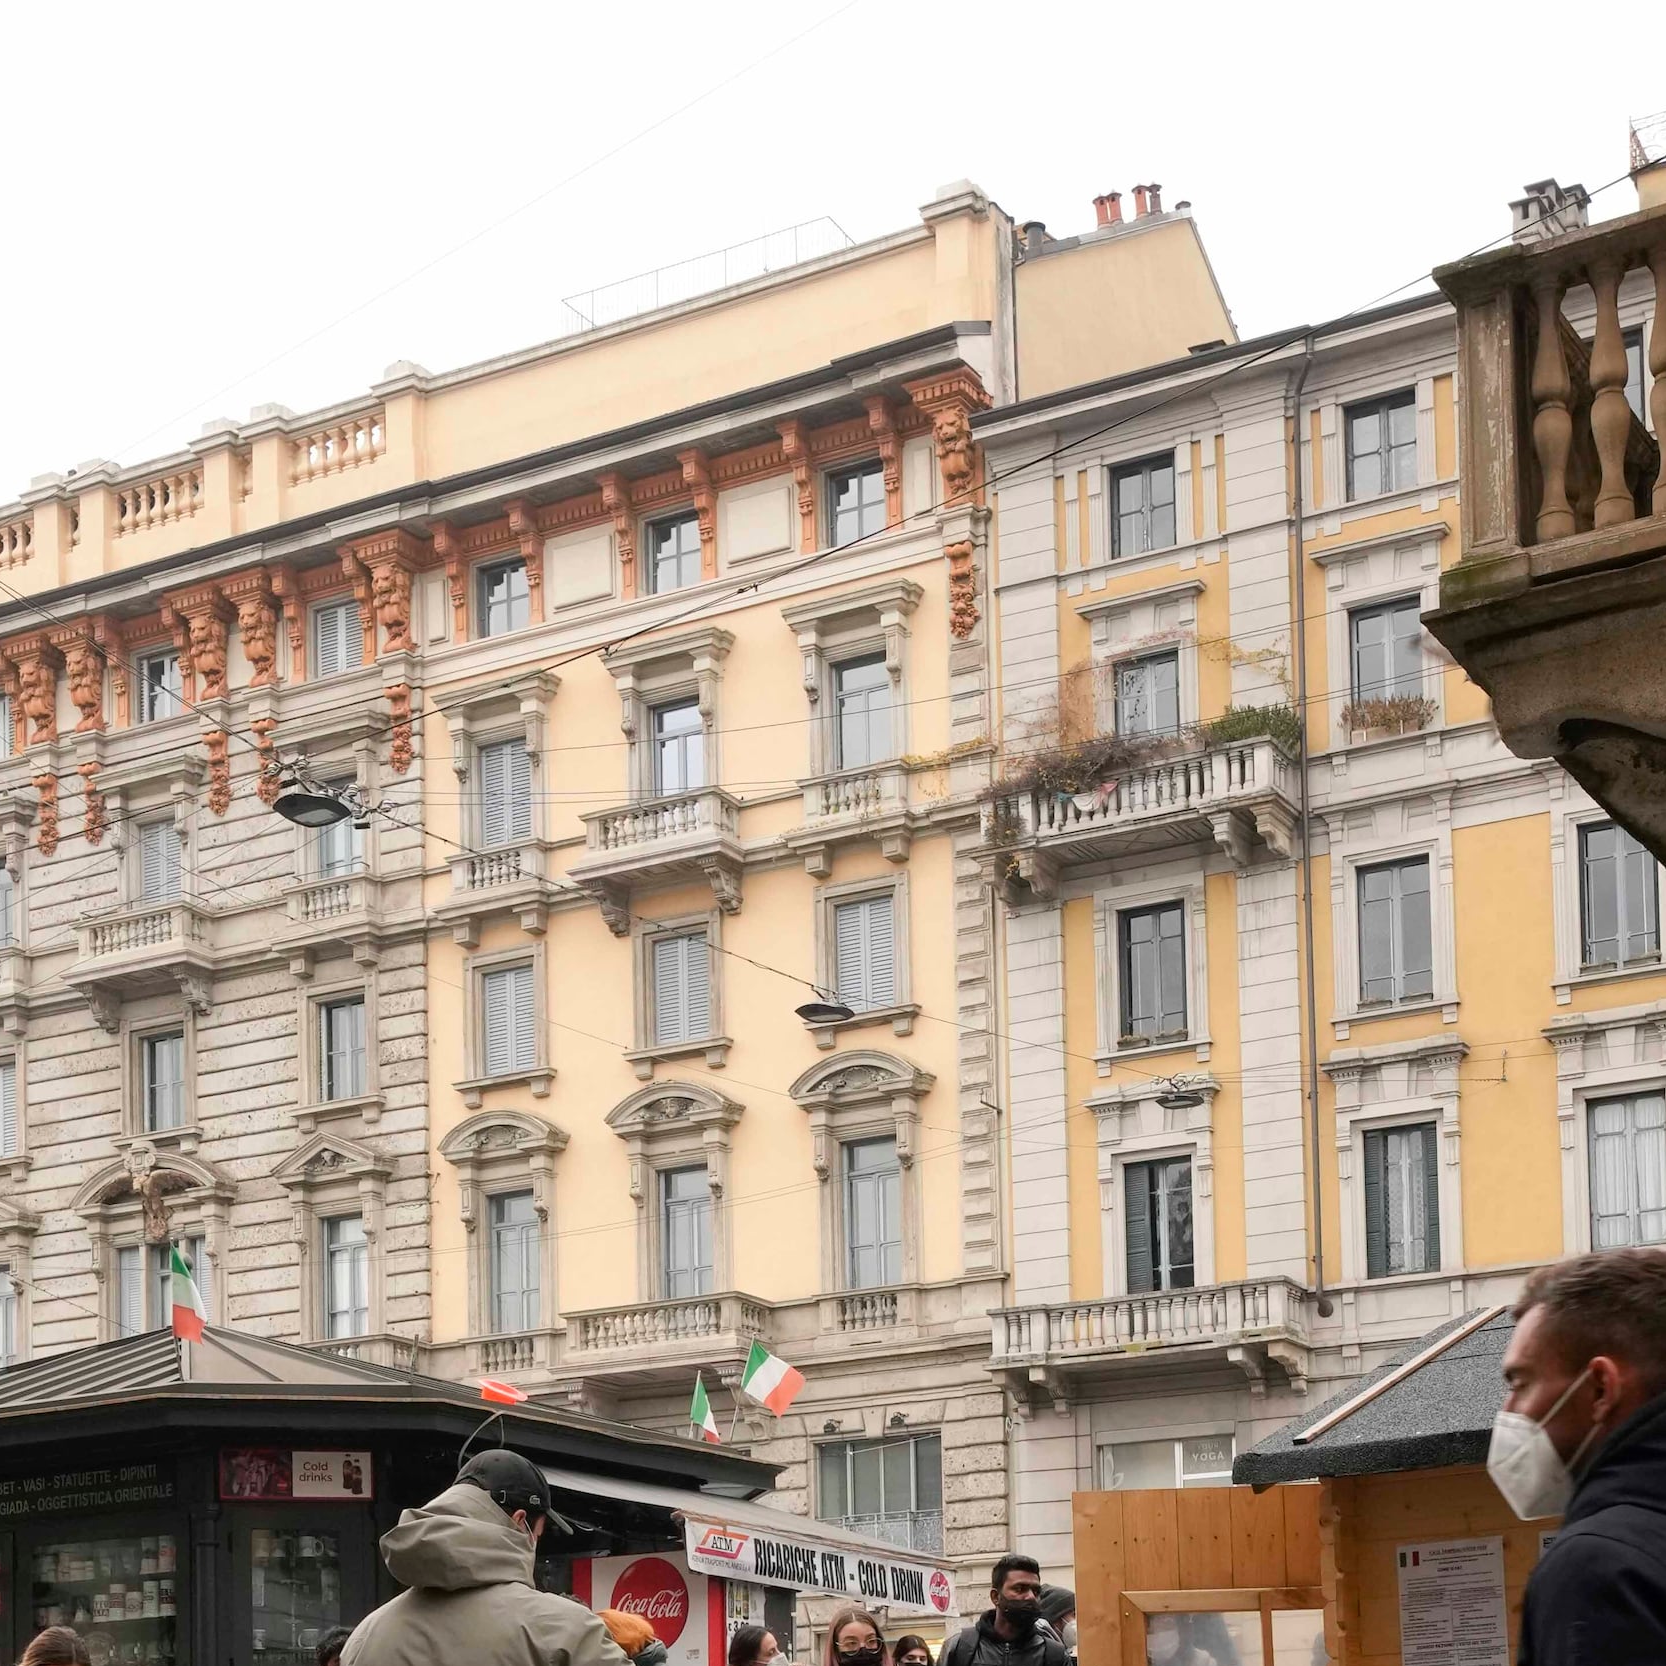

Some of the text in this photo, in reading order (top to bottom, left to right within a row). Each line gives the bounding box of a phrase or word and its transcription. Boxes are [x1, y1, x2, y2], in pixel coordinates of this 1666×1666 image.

[1192, 1451, 1225, 1462] YOGA
[303, 1461, 329, 1472] Cold
[23, 1477, 46, 1493] VASI
[53, 1469, 112, 1489] STATUETTE
[120, 1464, 157, 1481] DIPINTI
[298, 1471, 334, 1482] drinks
[37, 1490, 113, 1512] OGGETTISTICA
[114, 1483, 174, 1503] ORIENTALE
[711, 1535, 735, 1552] ATM
[754, 1538, 819, 1585] RICARICHE
[822, 1552, 847, 1591] ATM
[857, 1560, 888, 1599] COLD
[890, 1567, 925, 1605] DRINK
